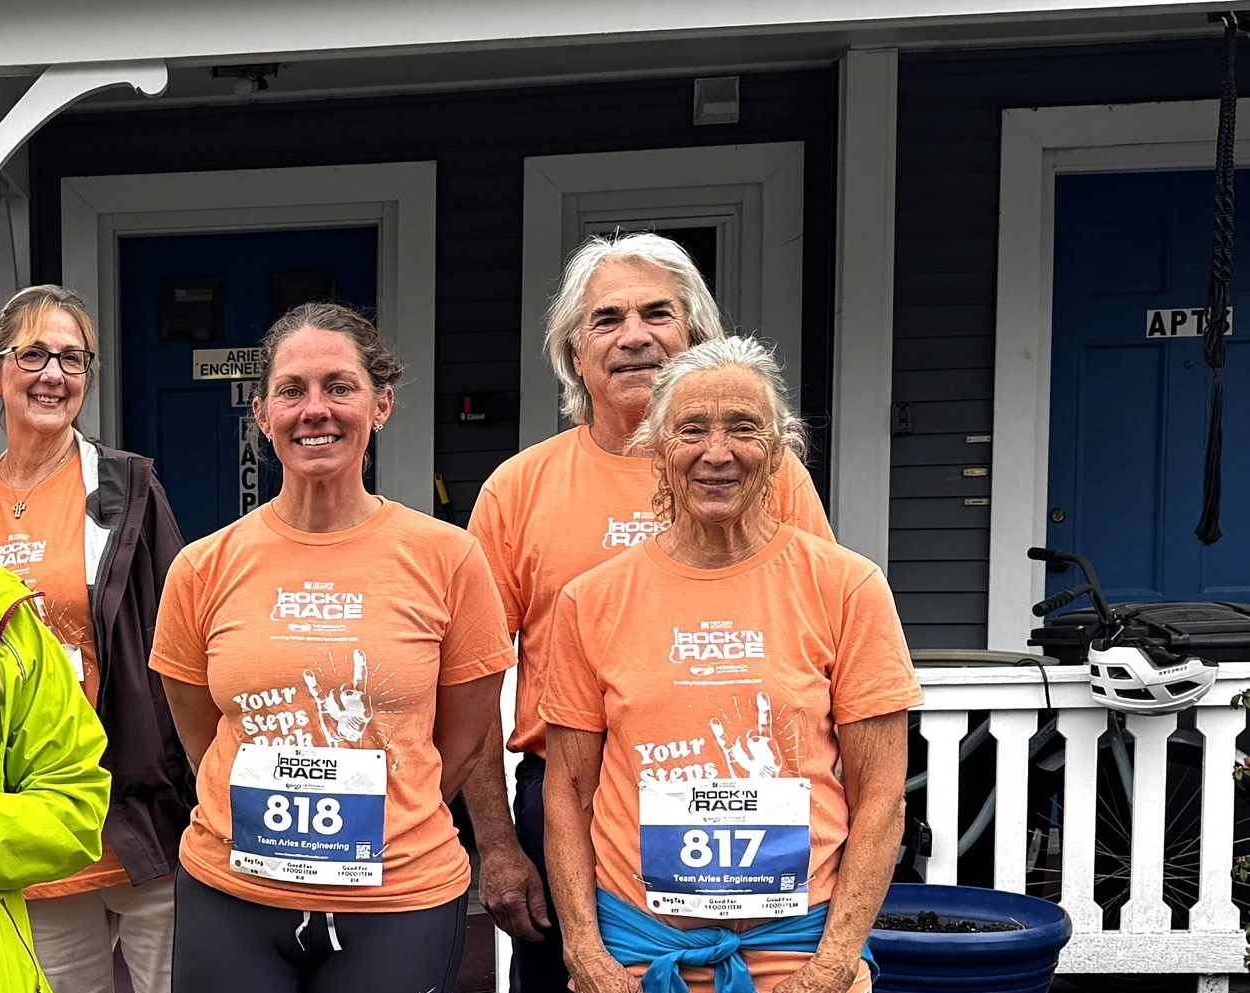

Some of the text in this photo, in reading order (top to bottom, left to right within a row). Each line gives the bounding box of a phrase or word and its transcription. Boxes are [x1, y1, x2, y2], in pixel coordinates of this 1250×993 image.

[226, 350, 261, 363] ARIE
[610, 532, 647, 547] RA
[281, 592, 363, 604] ROCK'N
[280, 603, 362, 620] RACE
[678, 630, 764, 644] ROCK'N
[679, 642, 765, 660] RACE
[233, 687, 296, 712] Your
[241, 709, 310, 736] Steps
[634, 737, 705, 764] Your
[280, 757, 337, 768] ROCK'N
[279, 766, 337, 780] RACE
[695, 790, 758, 799] ROCK'N
[695, 800, 758, 812] RACE
[263, 794, 343, 835] 818
[257, 835, 350, 851] Team Aries Engineering
[679, 828, 767, 868] 817
[673, 874, 696, 882] Team
[723, 875, 775, 884] Engineering
